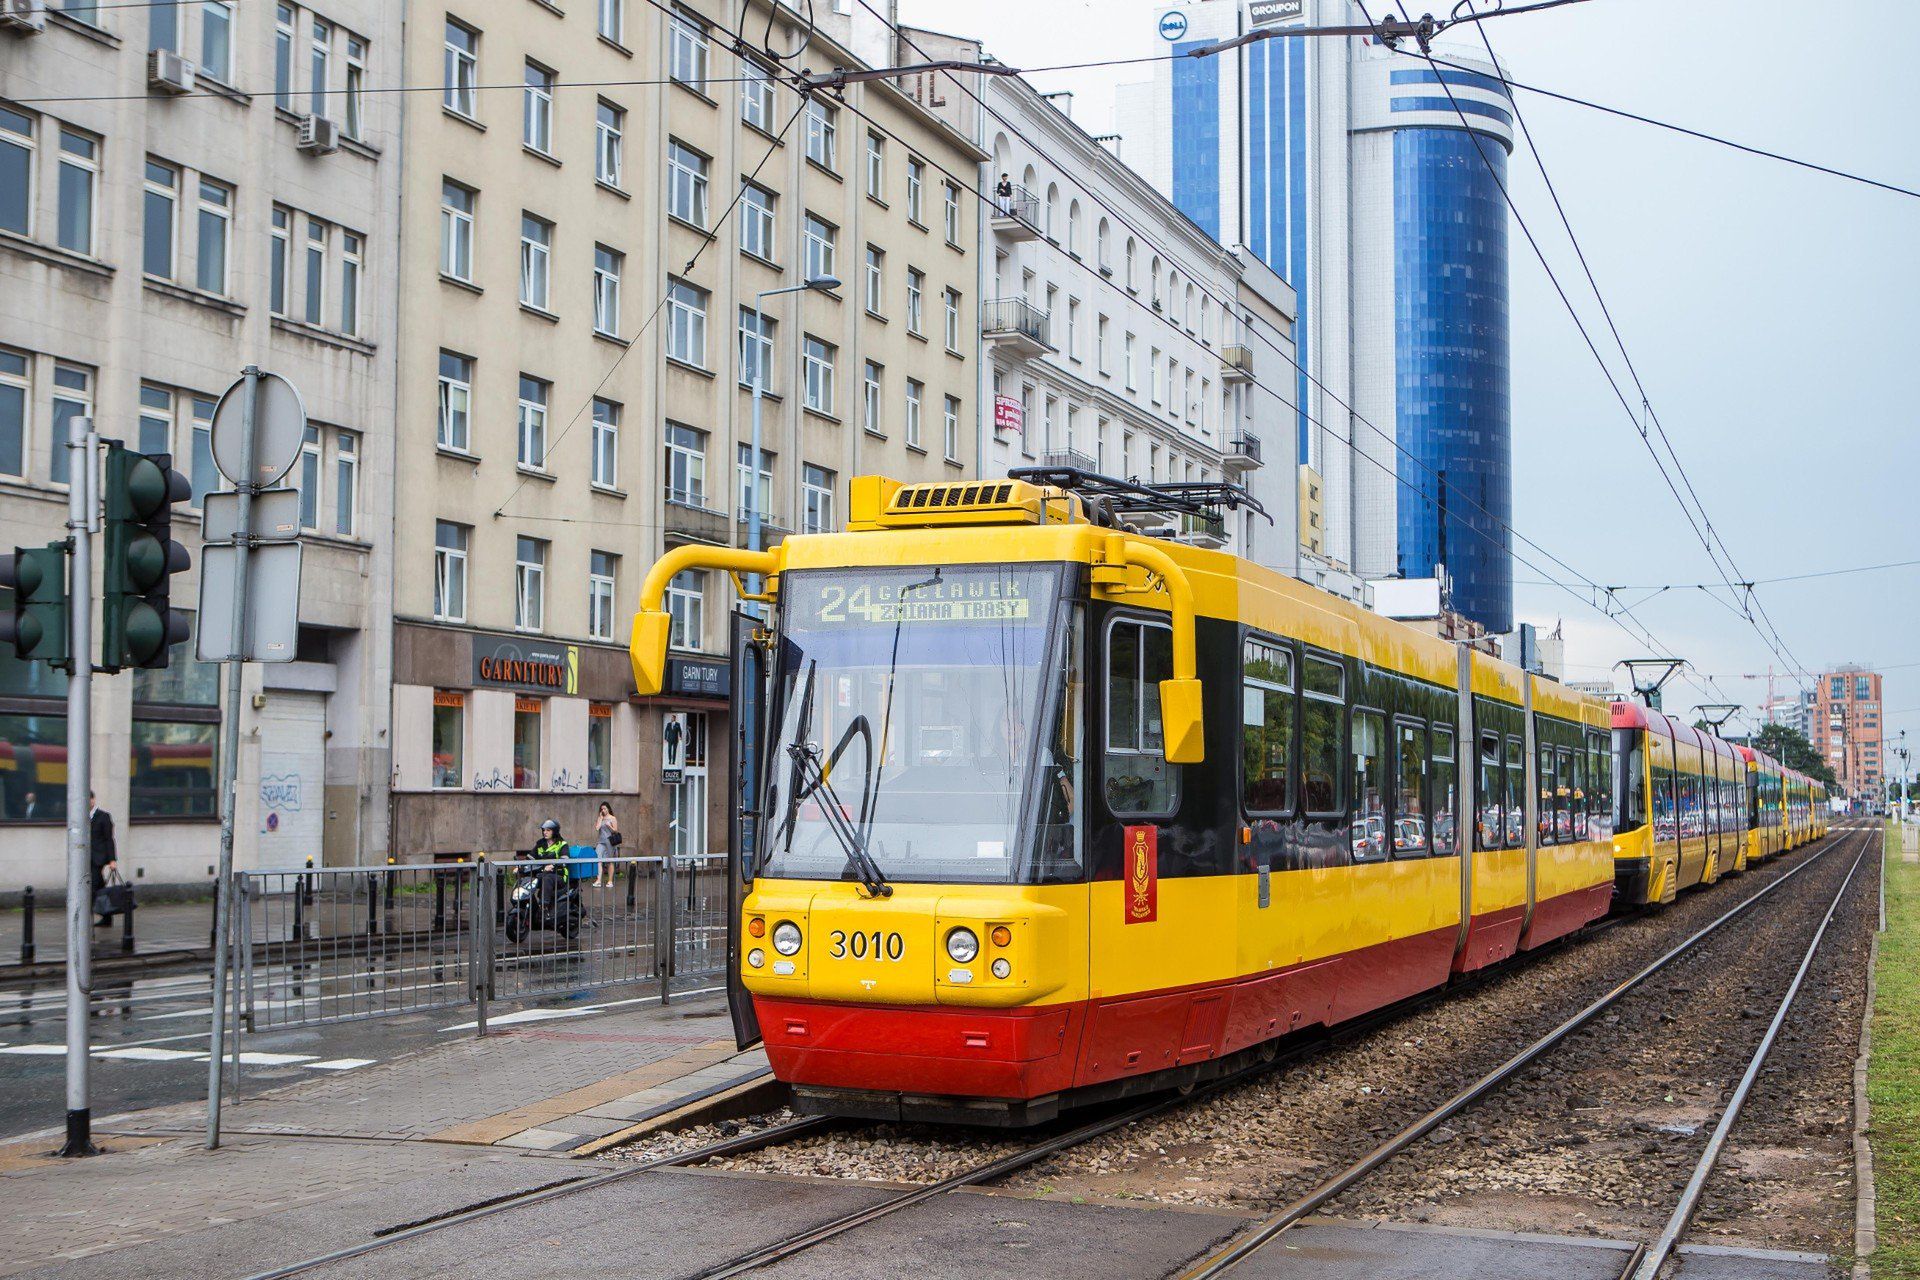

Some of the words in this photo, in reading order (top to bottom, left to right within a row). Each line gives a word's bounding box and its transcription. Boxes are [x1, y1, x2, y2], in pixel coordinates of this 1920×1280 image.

[1251, 2, 1300, 16] GROUPON
[1162, 22, 1184, 31] DELL
[820, 584, 872, 622] 24
[962, 601, 1020, 618] TRASY
[481, 656, 564, 687] GARNITURY
[828, 929, 905, 963] 3010
